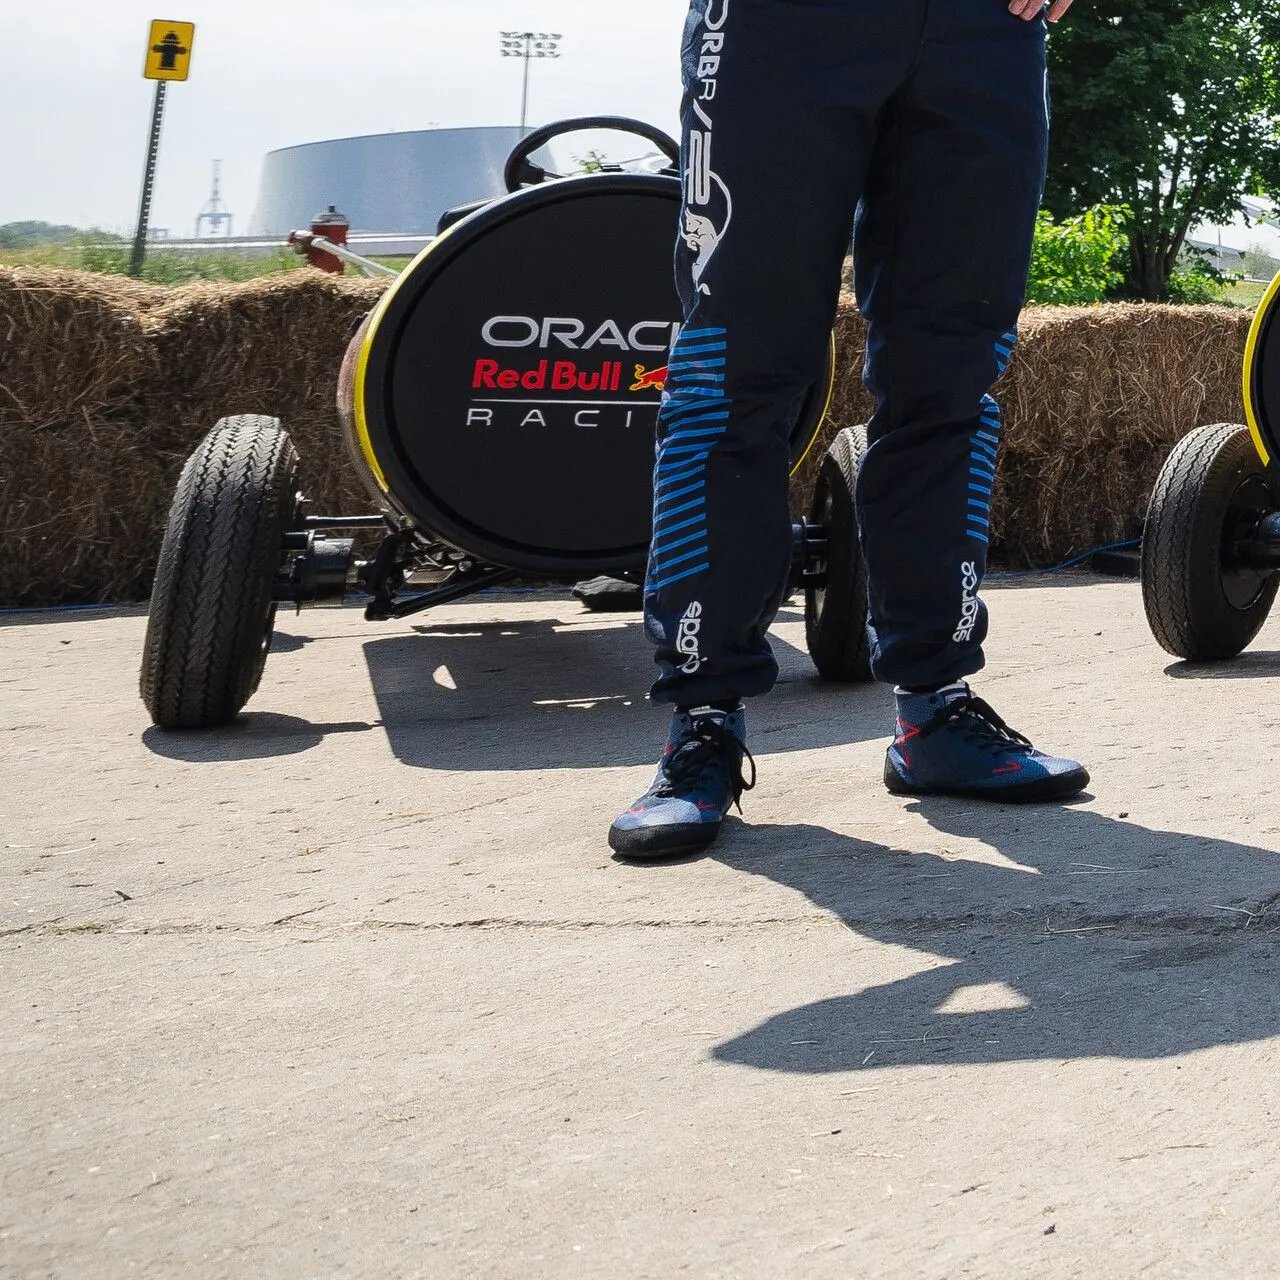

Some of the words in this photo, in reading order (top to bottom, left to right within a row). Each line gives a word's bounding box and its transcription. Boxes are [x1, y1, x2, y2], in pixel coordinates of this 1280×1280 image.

[471, 359, 547, 391] Red
[551, 361, 621, 392] Bull
[465, 408, 632, 428] RACI
[951, 560, 977, 643] sparco
